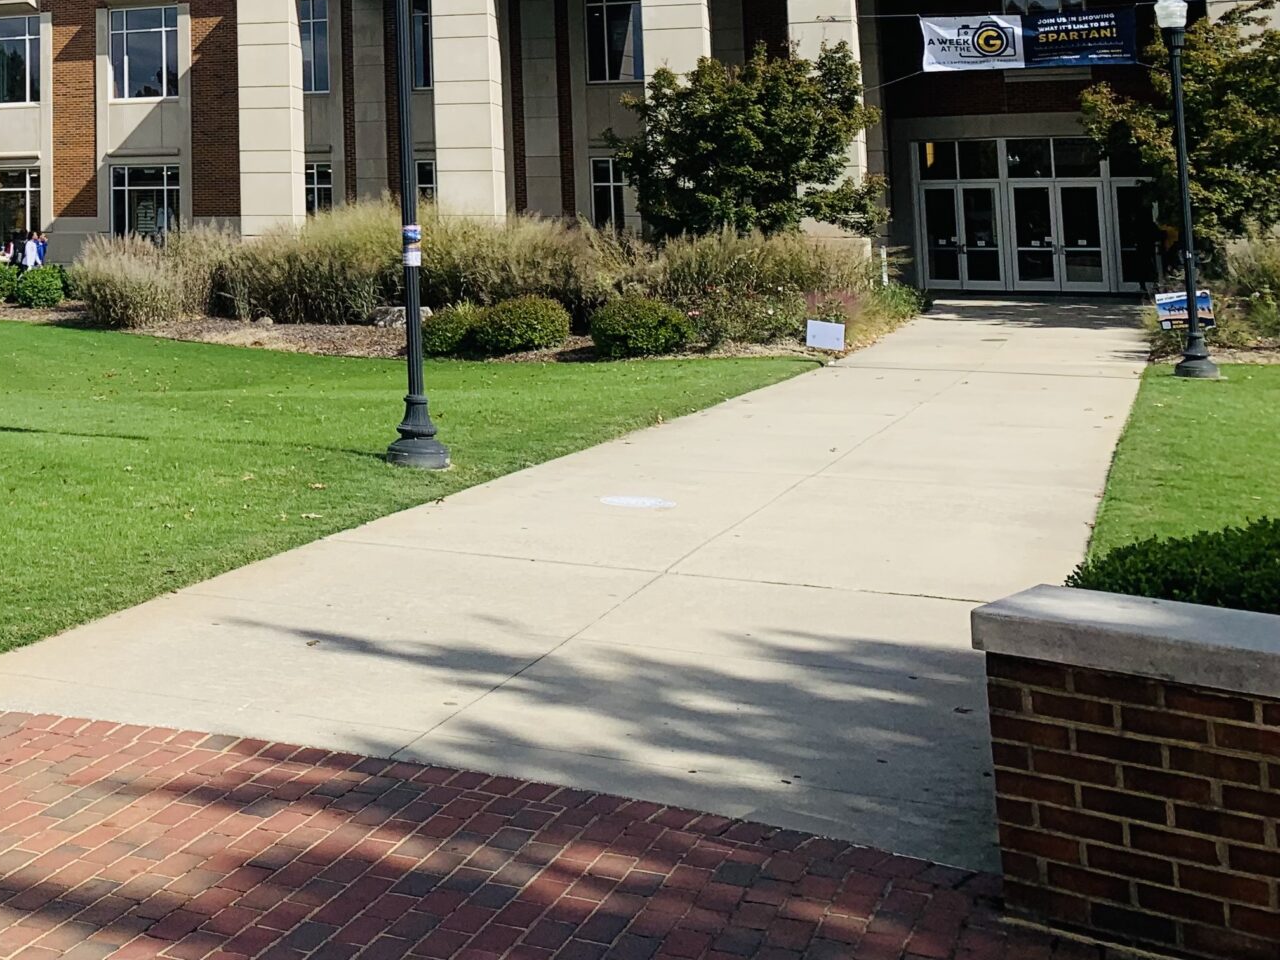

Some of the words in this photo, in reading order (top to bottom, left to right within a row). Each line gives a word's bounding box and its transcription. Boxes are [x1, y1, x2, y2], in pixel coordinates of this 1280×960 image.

[1078, 13, 1115, 22] SHOWING
[978, 30, 1002, 52] G
[1038, 27, 1117, 42] SPARTAN!
